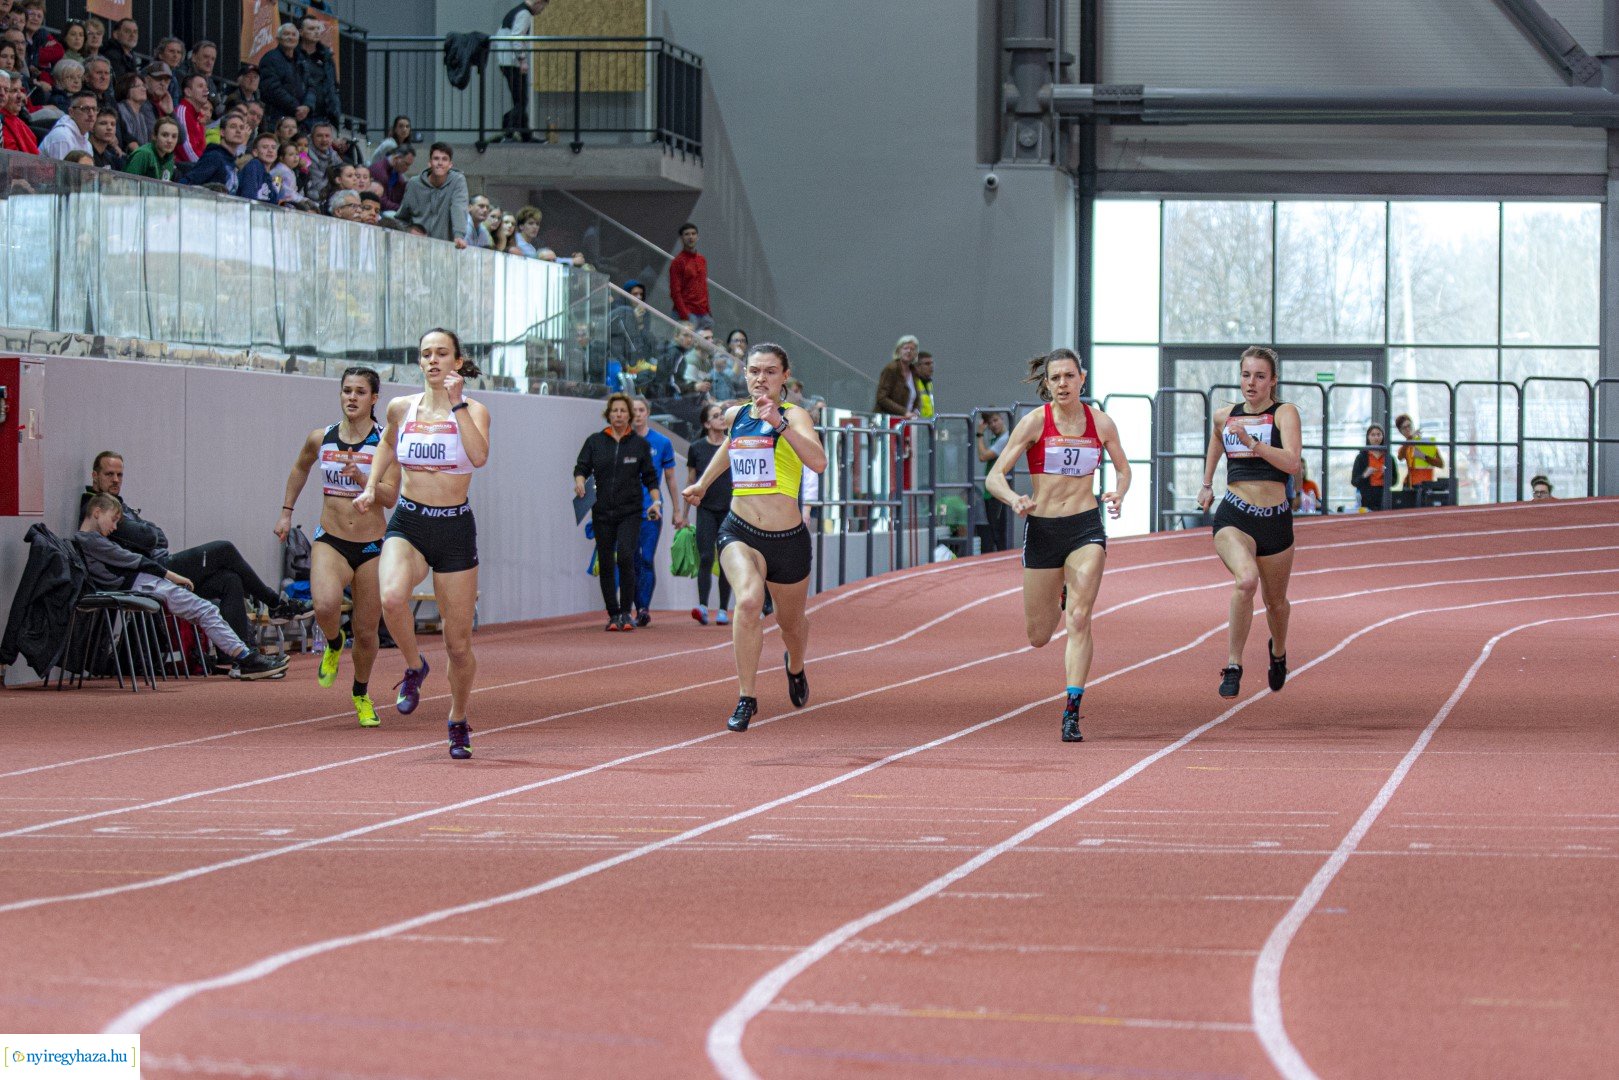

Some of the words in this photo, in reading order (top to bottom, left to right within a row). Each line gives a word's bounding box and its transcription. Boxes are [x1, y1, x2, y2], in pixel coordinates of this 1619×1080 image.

[408, 442, 446, 460] FODOR
[1063, 448, 1080, 466] 37
[733, 458, 757, 475] NAGY
[759, 458, 769, 475] P.
[421, 507, 458, 518] NIKE
[1225, 490, 1247, 511] NIKE
[1246, 505, 1274, 517] PRO
